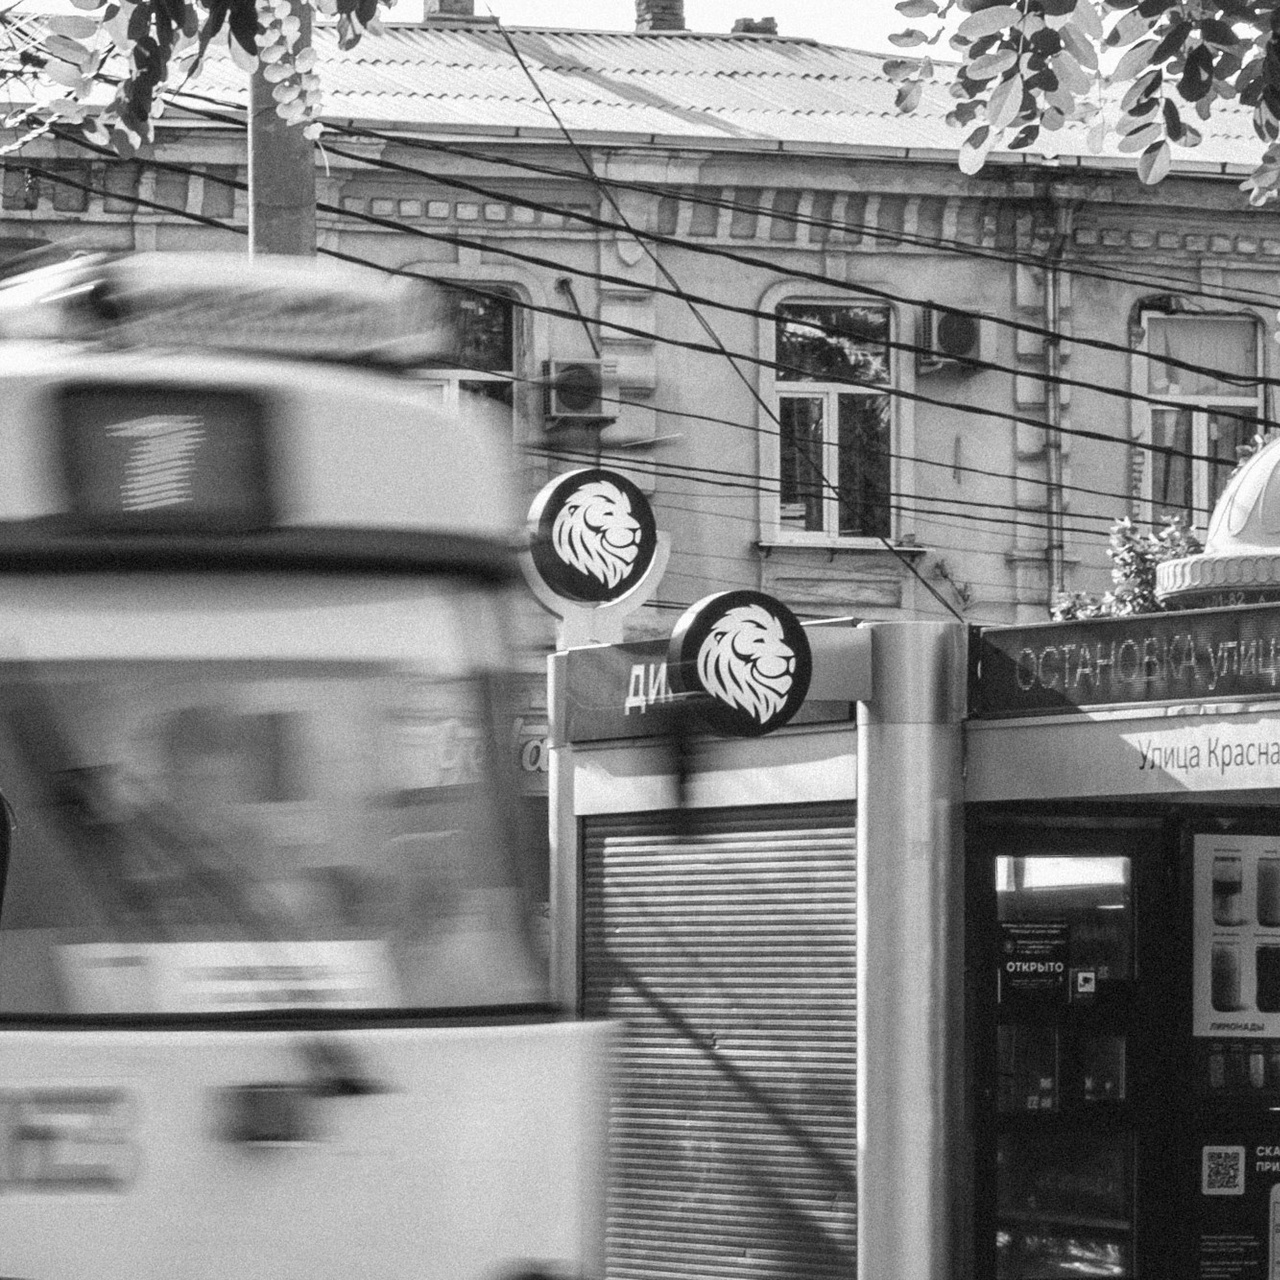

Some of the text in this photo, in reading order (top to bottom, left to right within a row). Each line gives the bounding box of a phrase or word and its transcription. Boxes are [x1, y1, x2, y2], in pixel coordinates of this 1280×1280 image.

[624, 662, 673, 716] ДИ
[1138, 736, 1280, 775] Улица Красна
[1006, 961, 1064, 973] ОТКРЫТО
